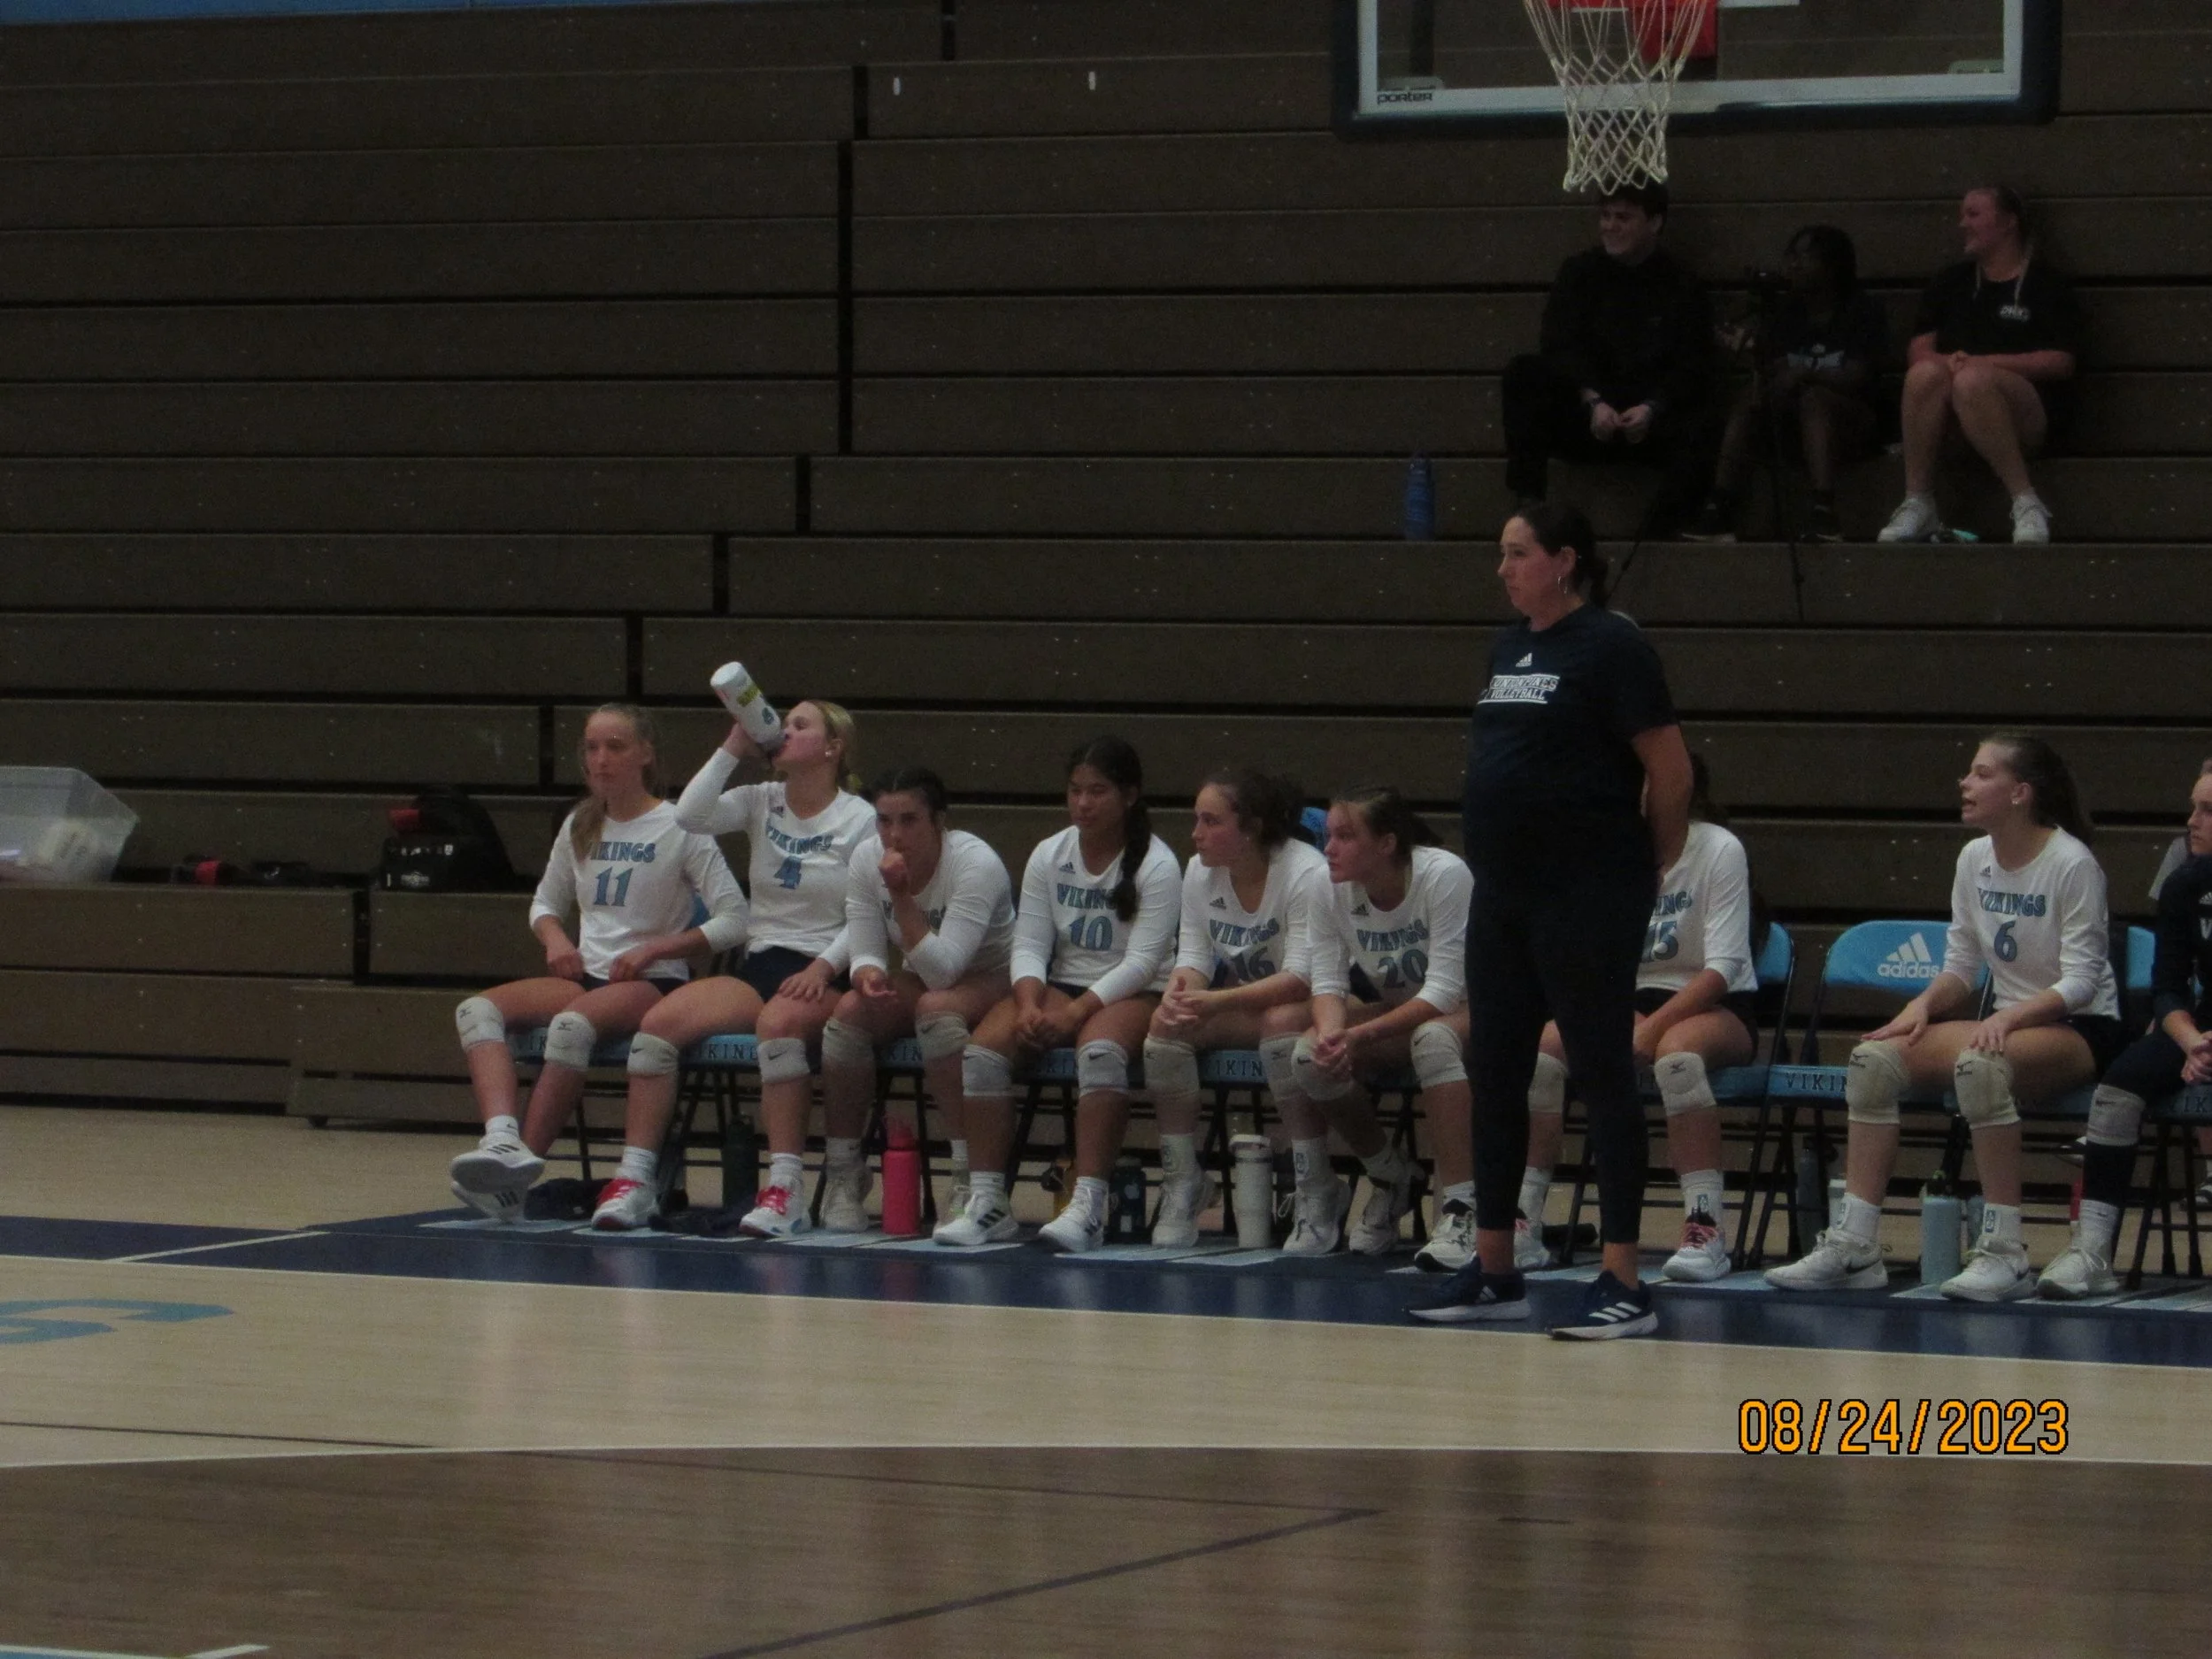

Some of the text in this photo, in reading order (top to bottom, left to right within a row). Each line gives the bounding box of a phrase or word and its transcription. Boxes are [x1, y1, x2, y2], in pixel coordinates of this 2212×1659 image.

[589, 841, 656, 864] IKINGS
[593, 866, 634, 907] 11
[773, 856, 802, 890] 4
[1978, 887, 2047, 918] VIKINGS
[1069, 915, 1113, 952] 10
[1210, 917, 1279, 948] VIKINGS
[1356, 918, 1429, 951] VIKINGS
[1993, 920, 2018, 963] 6
[1230, 947, 1276, 982] 16
[1377, 949, 1429, 988] 20
[1876, 959, 1942, 979] adidas
